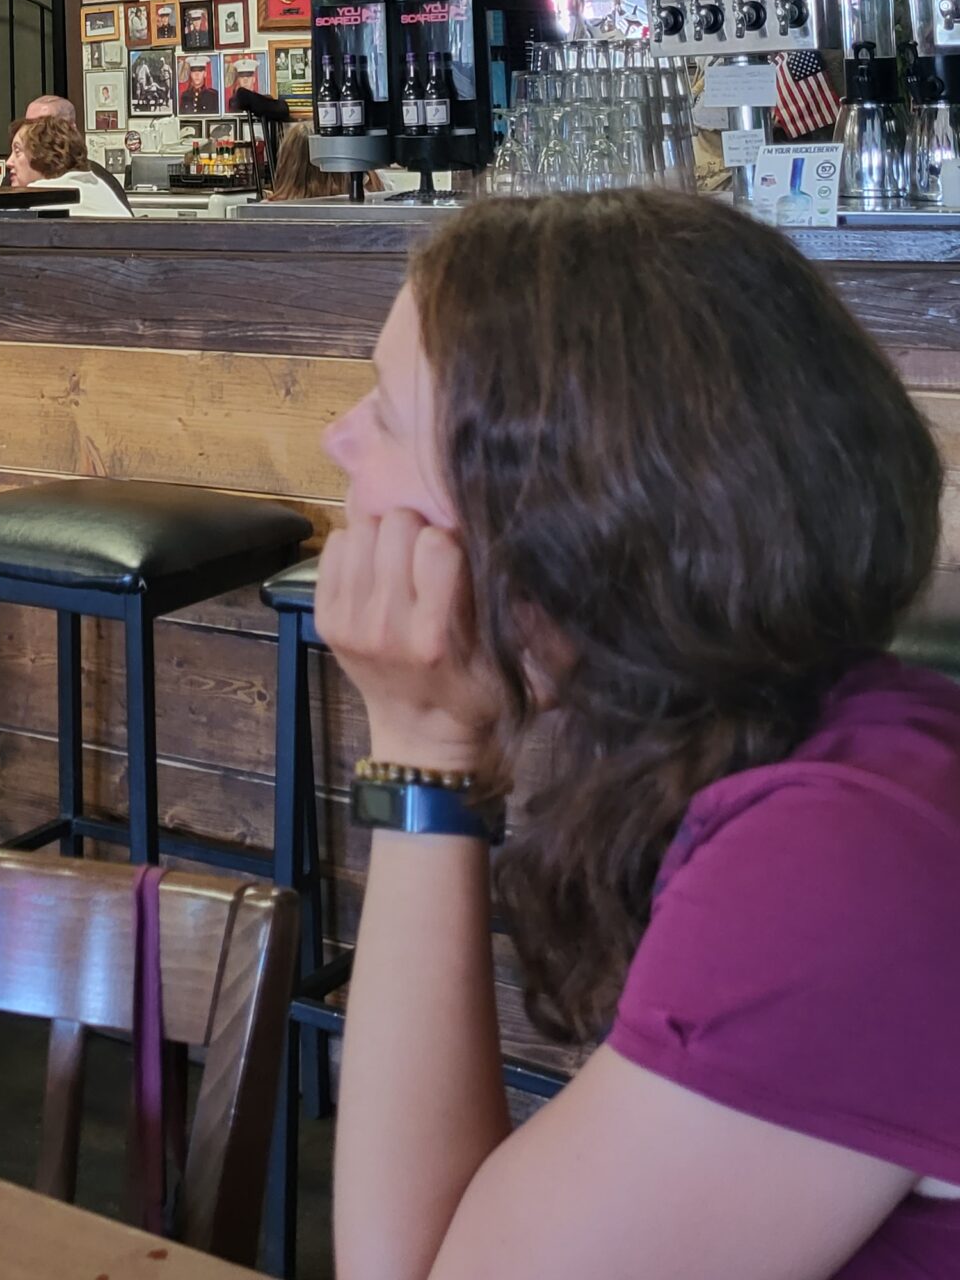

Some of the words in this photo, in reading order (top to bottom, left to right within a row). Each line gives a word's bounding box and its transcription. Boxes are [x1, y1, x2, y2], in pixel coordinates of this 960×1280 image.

[337, 7, 361, 16] YOU
[423, 2, 448, 13] YOU
[315, 16, 361, 27] SCARED
[401, 13, 448, 24] SCARED
[774, 147, 791, 155] YOUR
[792, 146, 839, 154] HUCKLEBERRY
